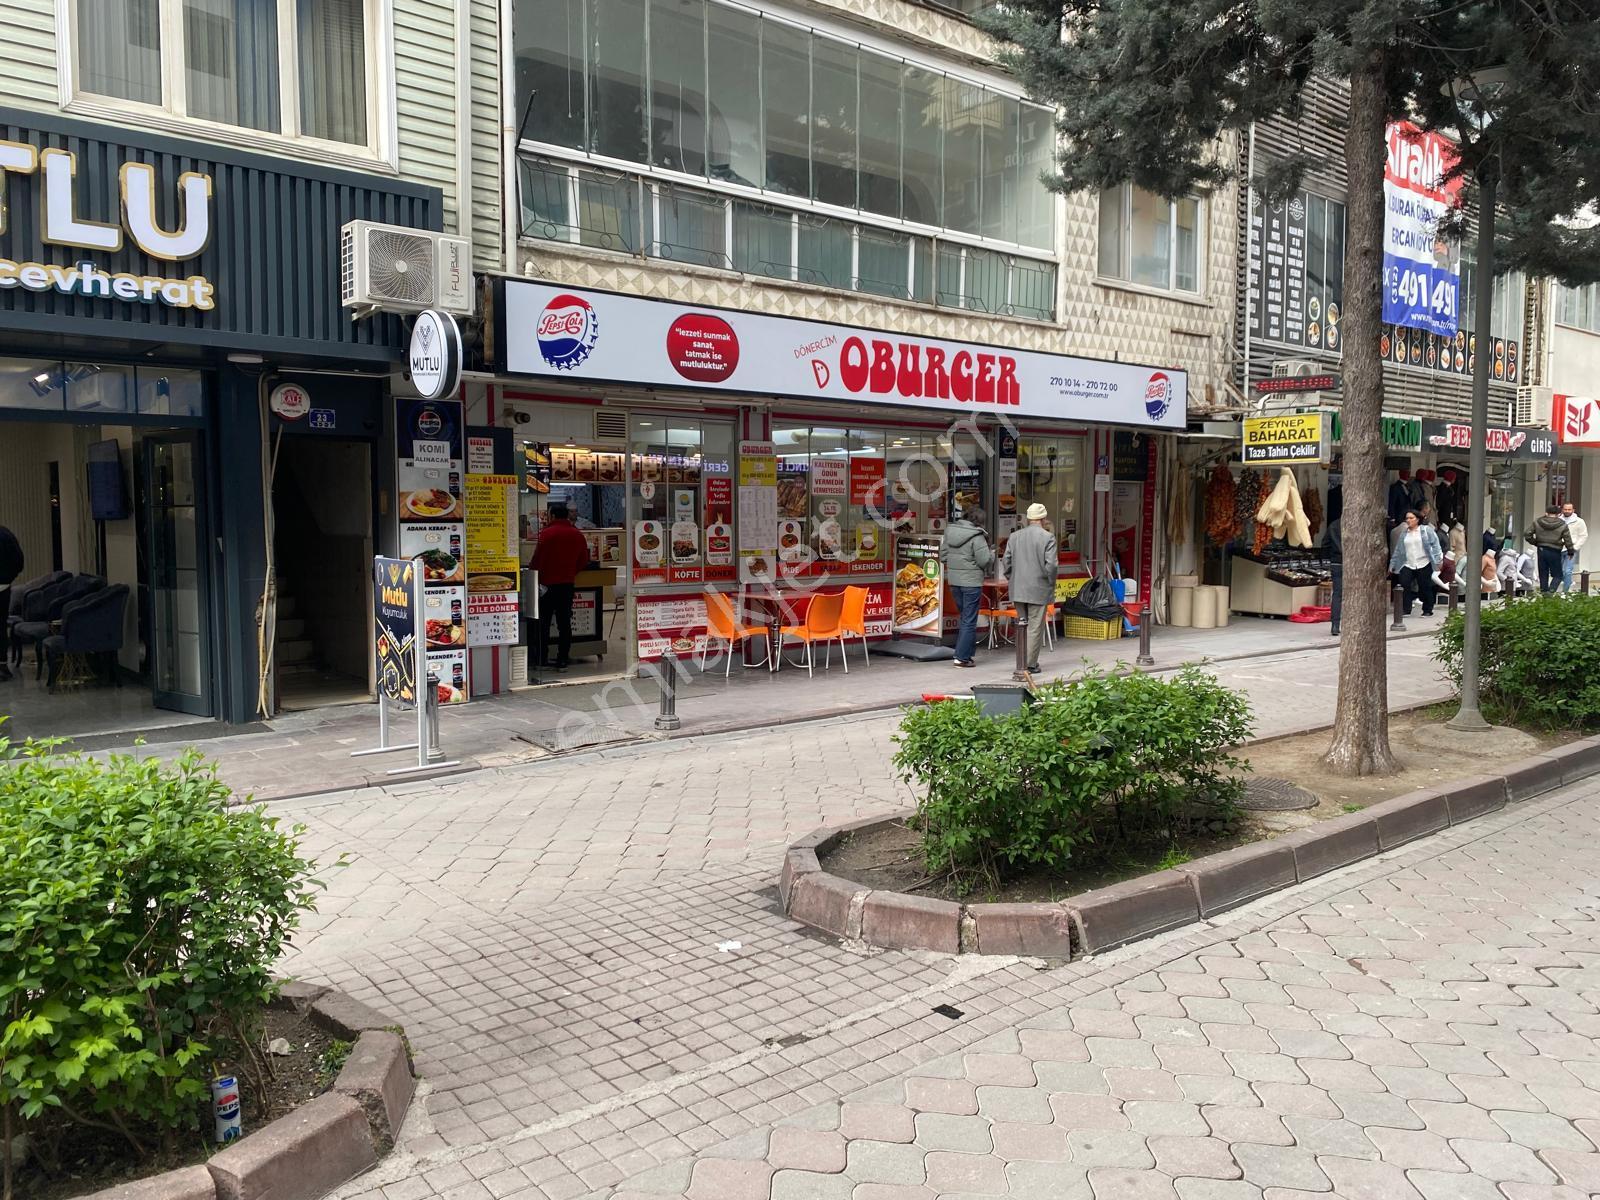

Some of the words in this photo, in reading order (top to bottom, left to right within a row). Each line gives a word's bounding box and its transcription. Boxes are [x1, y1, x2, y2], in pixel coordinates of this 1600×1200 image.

[0, 262, 211, 307] cevherat
[1398, 269, 1428, 308] 491
[703, 331, 731, 342] sunmak
[693, 341, 715, 351] sanat,
[793, 334, 838, 360] DÖNERCİM
[685, 350, 711, 360] tatmak
[711, 351, 722, 360] ise
[413, 357, 440, 371] MUTLU
[839, 335, 1020, 406] OBURGER
[1050, 376, 1062, 386] 270
[1064, 378, 1072, 387] 10
[1073, 379, 1080, 388] 14
[1086, 380, 1098, 389] 270
[1100, 382, 1107, 391] 72
[1109, 383, 1118, 392] 00
[1059, 388, 1109, 399] www.oburger.com.tr
[1260, 419, 1304, 430] ZEYNEP
[1249, 428, 1316, 443] BAHARAT
[419, 444, 445, 454] KOMİ
[1249, 448, 1266, 459] Taze
[1268, 446, 1289, 457] Tahin
[1291, 444, 1317, 459] Çekilir
[1531, 437, 1553, 457] GİRİŞ
[813, 462, 845, 470] KALİTEDEN
[821, 469, 838, 478] ÖDÜN
[814, 478, 844, 486] VERMEDİK
[382, 585, 408, 608] Mutlu
[382, 605, 408, 621] Kuyumculuk
[490, 604, 516, 612] DÖNER
[866, 607, 878, 615] VE
